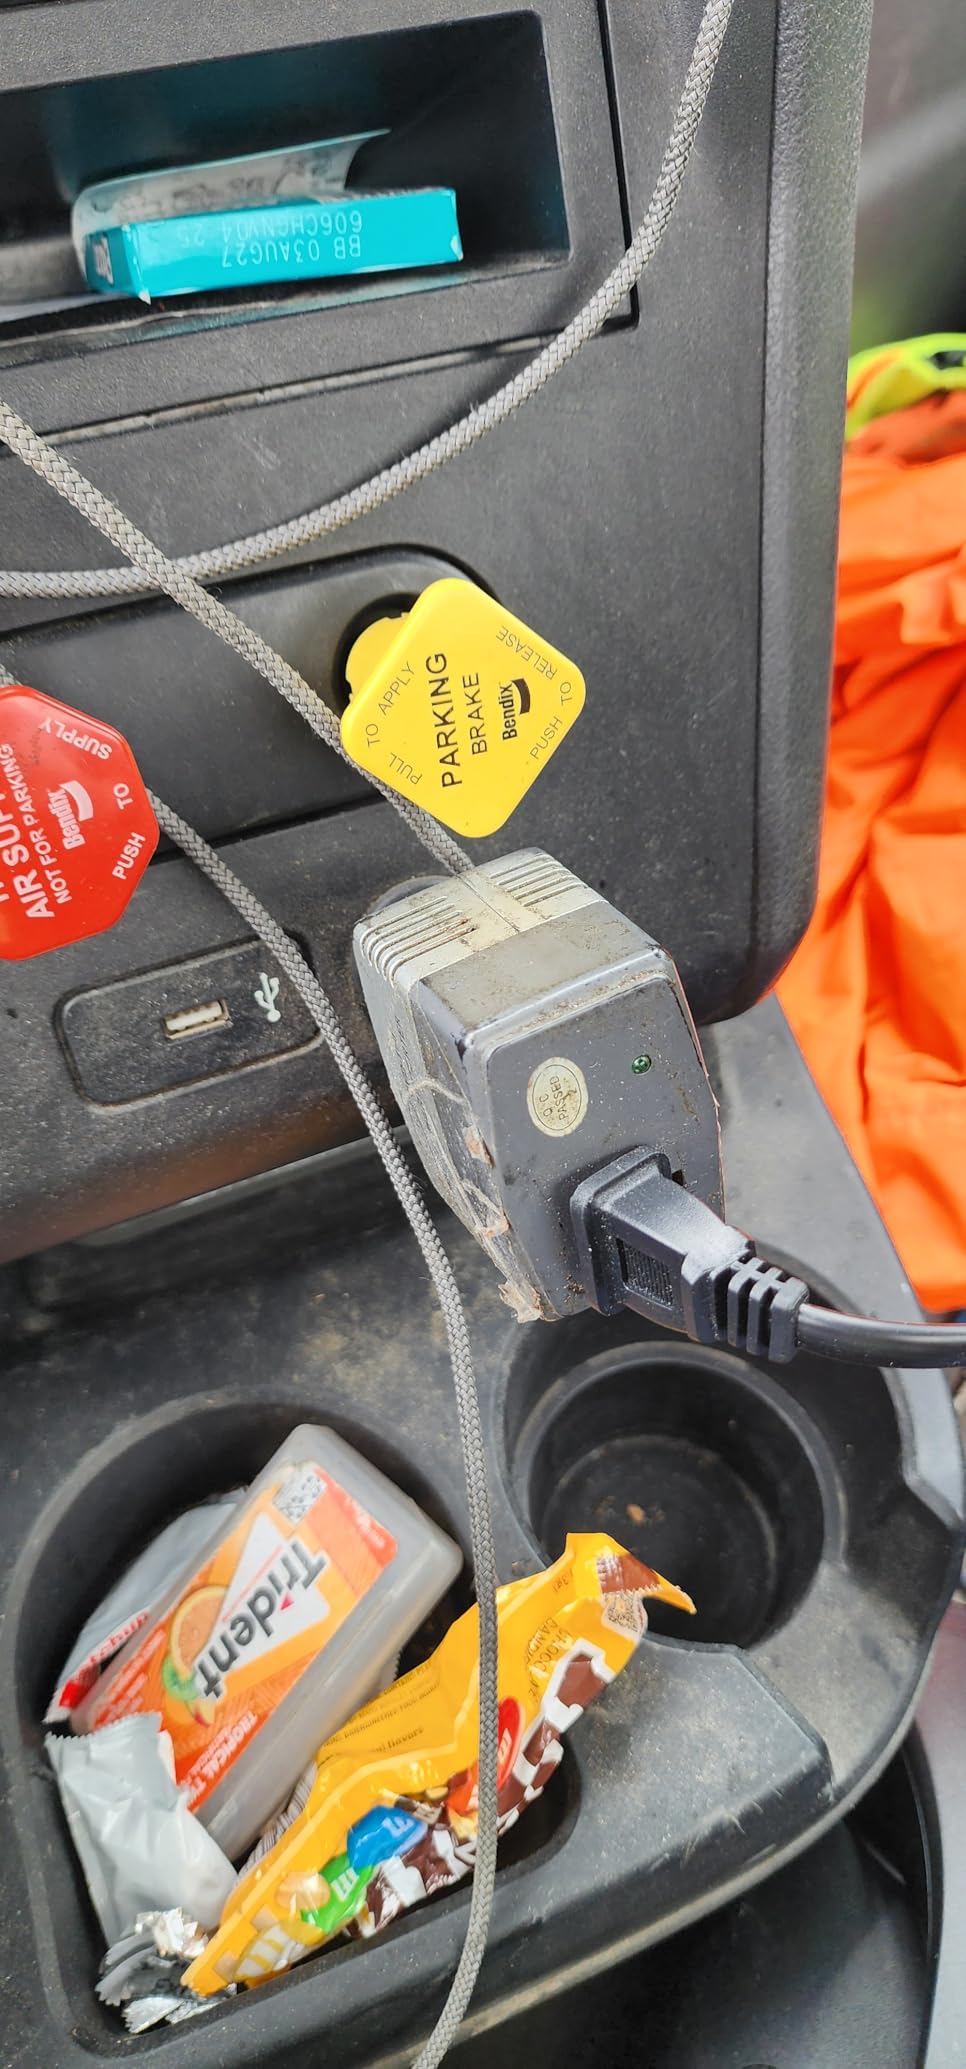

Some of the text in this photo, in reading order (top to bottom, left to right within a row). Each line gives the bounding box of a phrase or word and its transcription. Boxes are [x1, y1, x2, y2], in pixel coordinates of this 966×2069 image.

[222, 234, 361, 268] BB 03AUG27
[366, 661, 423, 785] PULL TO APPLY
[425, 652, 463, 788] PARKING
[462, 672, 488, 756] BRAKE
[495, 625, 573, 760] PUSH TO RELEASE
[498, 682, 518, 742] Bendix
[0, 743, 73, 905] NOT FOR PARKING
[38, 716, 146, 880] PUSH TO SUPPLY
[47, 788, 86, 850] Bendix
[12, 868, 56, 918] AIR
[549, 1075, 569, 1121] PASSED
[196, 1538, 329, 1699] Trident
